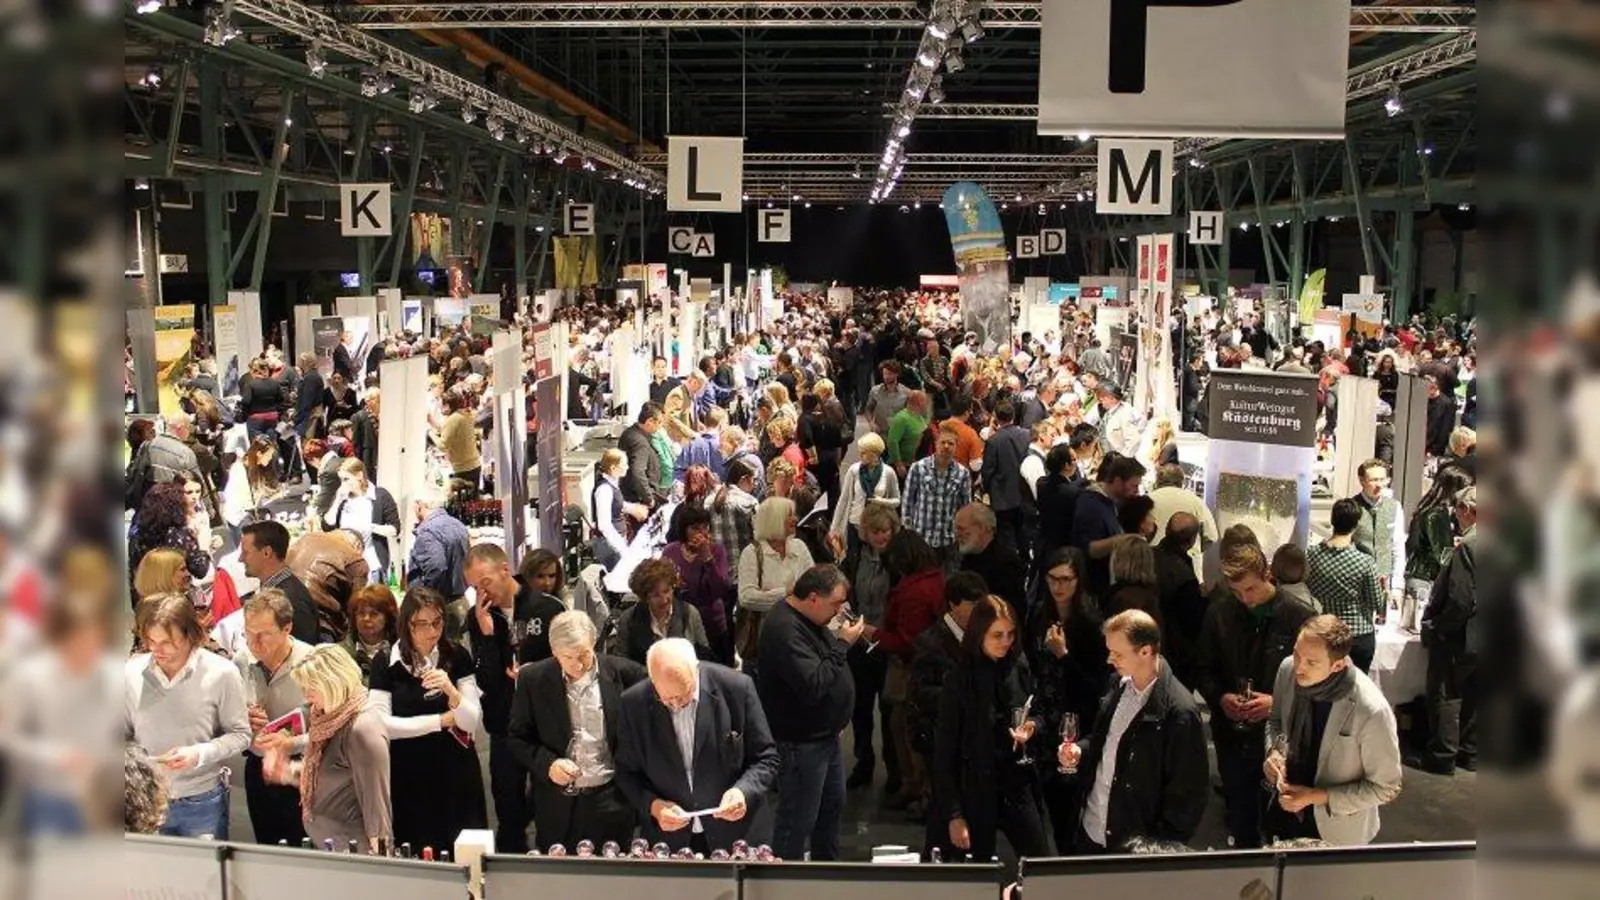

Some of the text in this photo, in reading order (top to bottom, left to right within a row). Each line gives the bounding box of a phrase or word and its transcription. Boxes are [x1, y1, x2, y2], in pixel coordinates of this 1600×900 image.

[688, 147, 721, 201] L
[1109, 149, 1161, 204] M
[351, 191, 381, 229] K
[569, 206, 589, 232] E
[765, 212, 784, 239] F
[1197, 216, 1216, 240] H
[671, 229, 691, 251] C
[695, 236, 712, 254] A
[1021, 239, 1035, 255] B
[1045, 231, 1062, 253] D
[1223, 411, 1301, 431] Kästenburg
